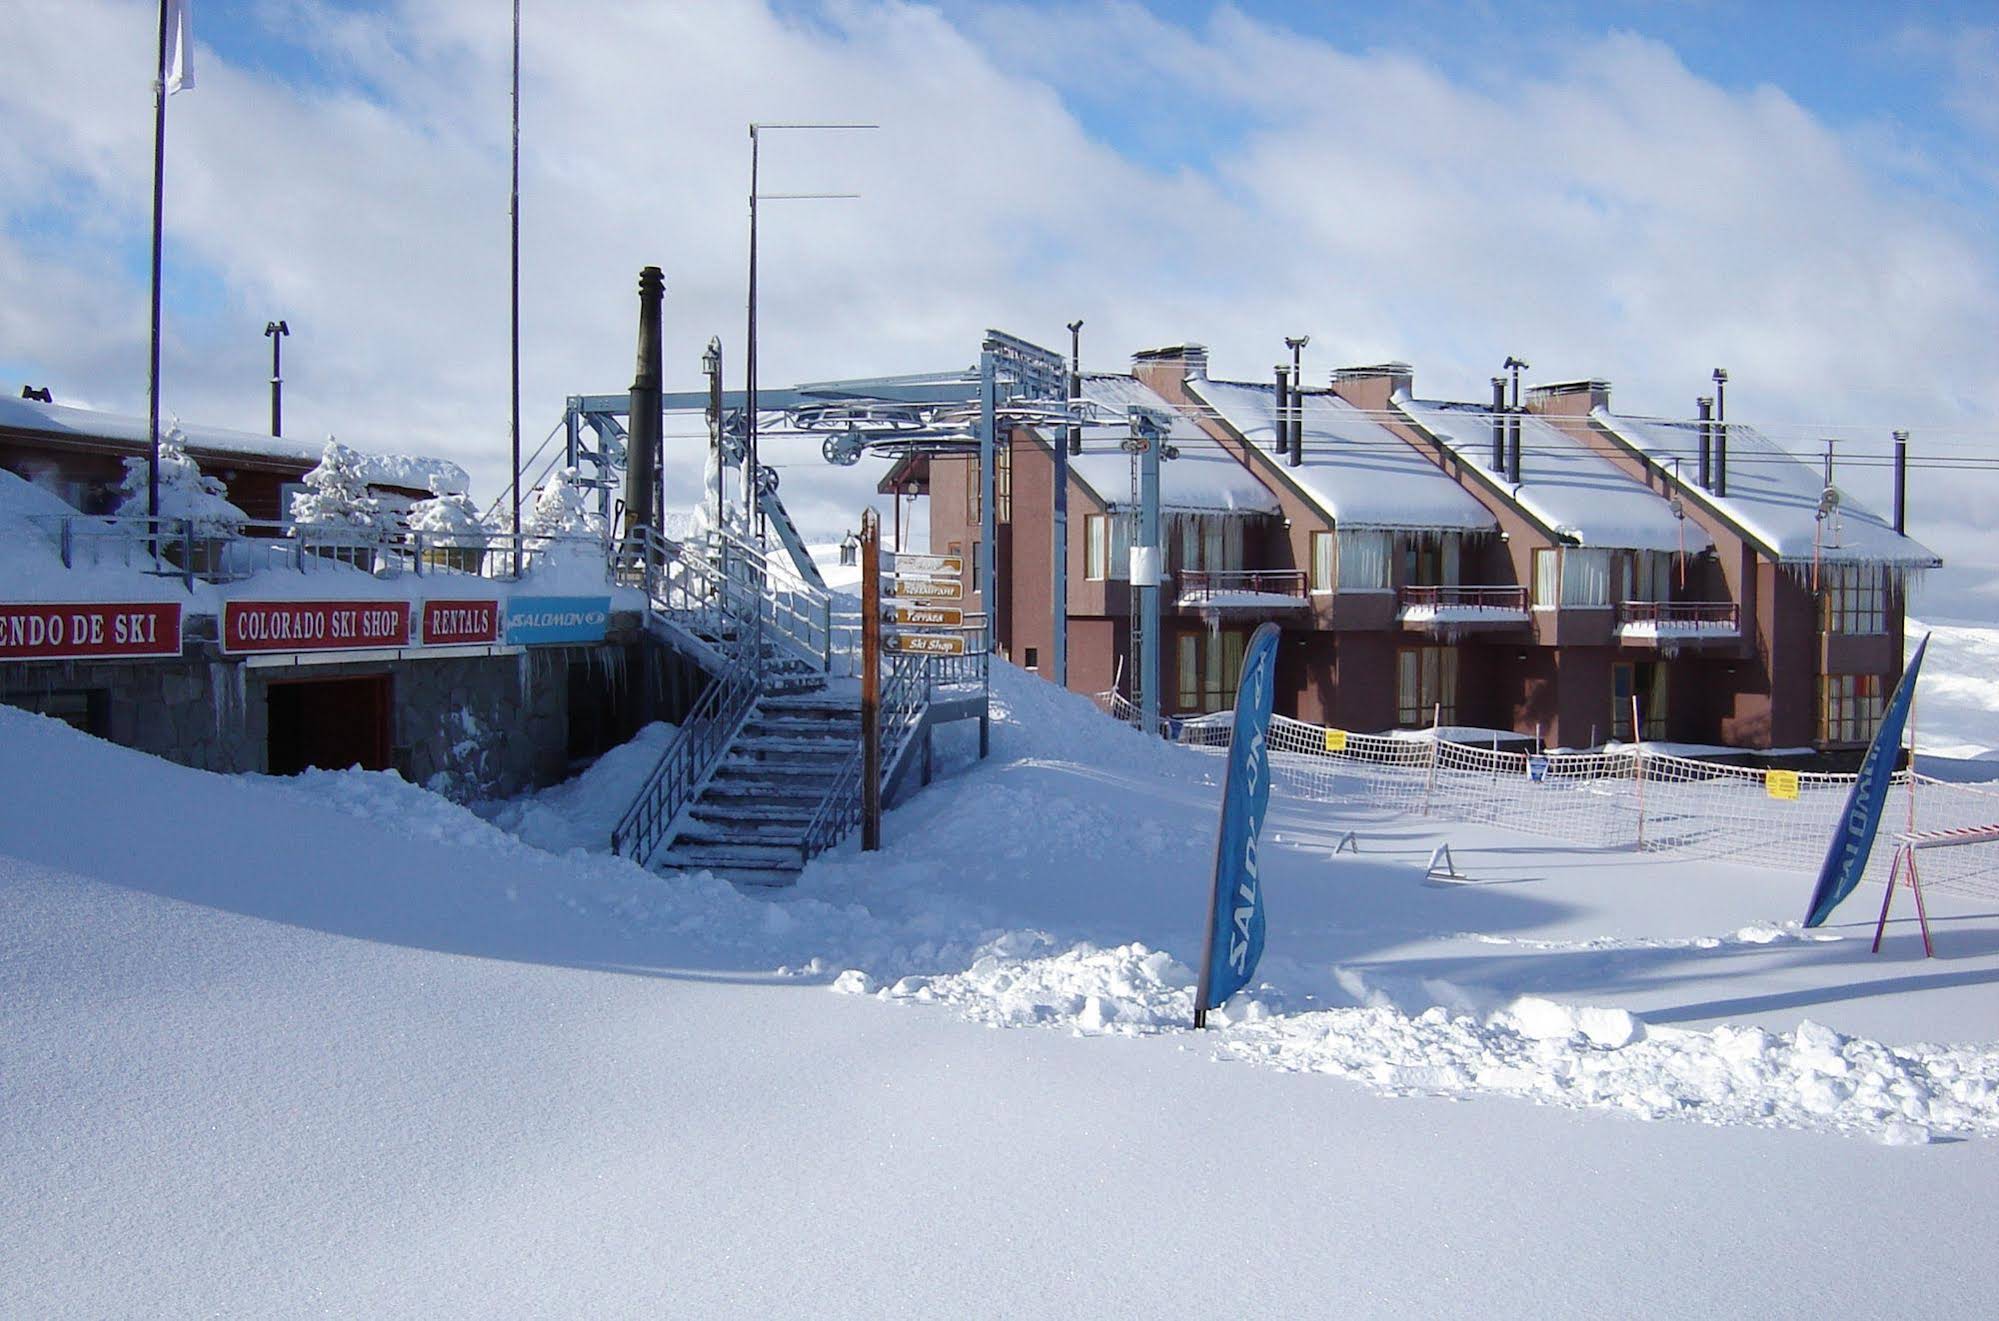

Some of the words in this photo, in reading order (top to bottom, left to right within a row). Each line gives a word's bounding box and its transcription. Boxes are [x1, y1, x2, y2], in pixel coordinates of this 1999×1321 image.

[72, 614, 105, 645] DE
[115, 614, 157, 644] SKI
[238, 611, 325, 640] COLORADO
[331, 611, 357, 638] SKI
[363, 610, 399, 637] SHOP
[432, 609, 489, 635] RENTALS
[909, 639, 927, 650] Ski
[928, 640, 953, 653] Shop
